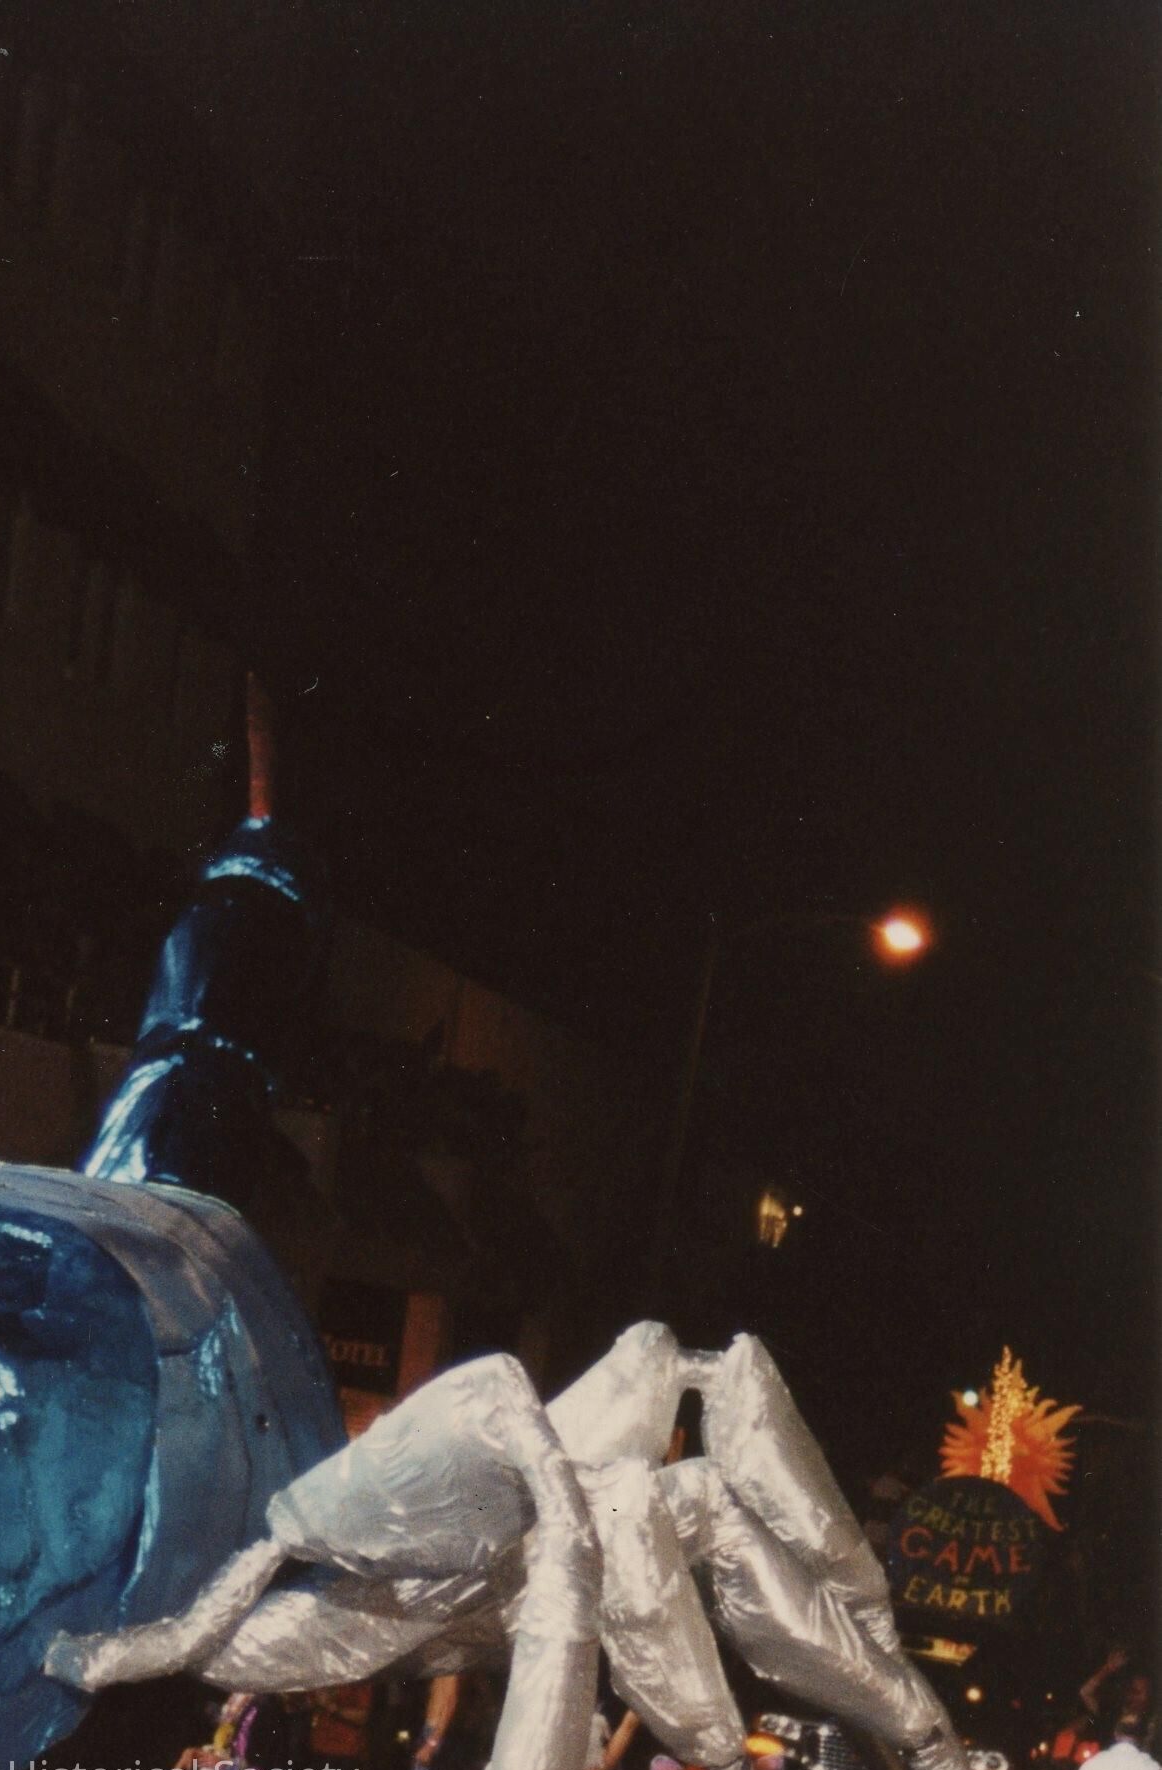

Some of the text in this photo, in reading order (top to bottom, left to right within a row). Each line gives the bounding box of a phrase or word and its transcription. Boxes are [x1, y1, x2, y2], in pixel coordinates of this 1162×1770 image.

[907, 1496, 1036, 1541] GREATEST
[901, 1526, 1031, 1575] GAME
[903, 1576, 1012, 1616] EARTH
